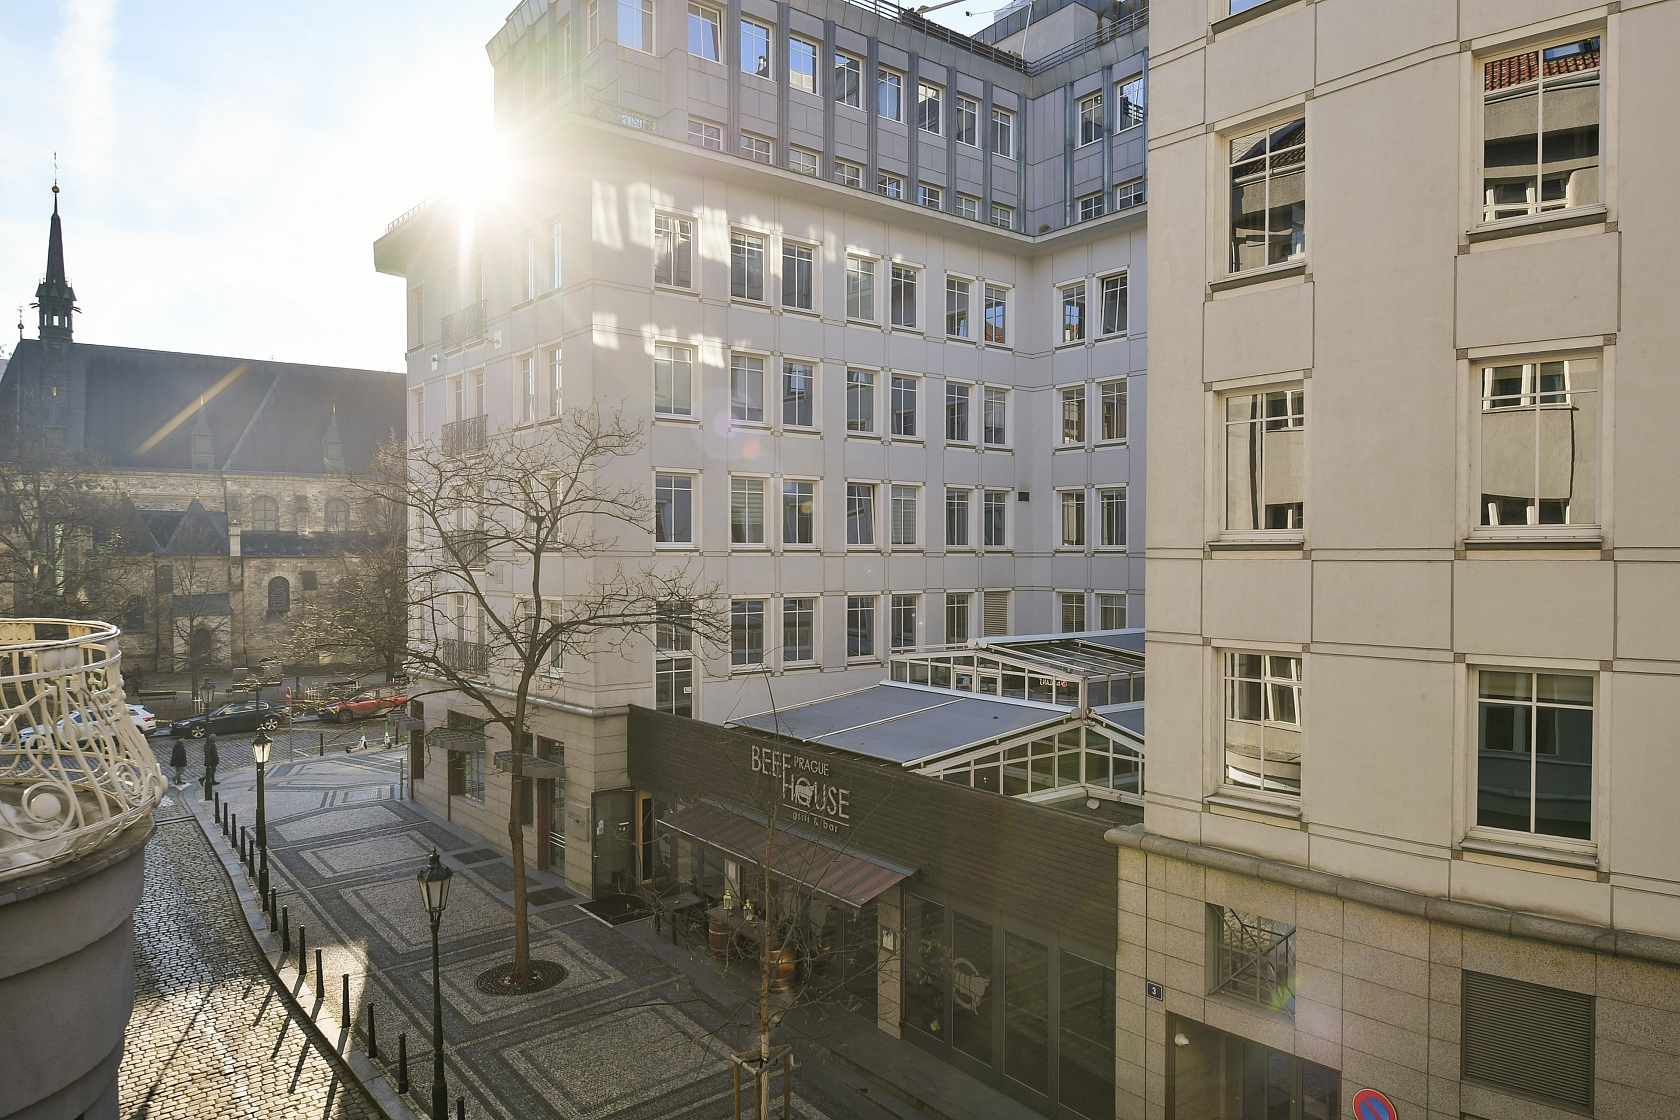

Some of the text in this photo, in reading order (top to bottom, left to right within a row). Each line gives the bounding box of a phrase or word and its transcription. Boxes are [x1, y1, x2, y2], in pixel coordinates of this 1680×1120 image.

[751, 745, 829, 778] BEEF PRAGUE
[782, 773, 850, 819] HOUSE
[792, 812, 838, 833] grill & bar
